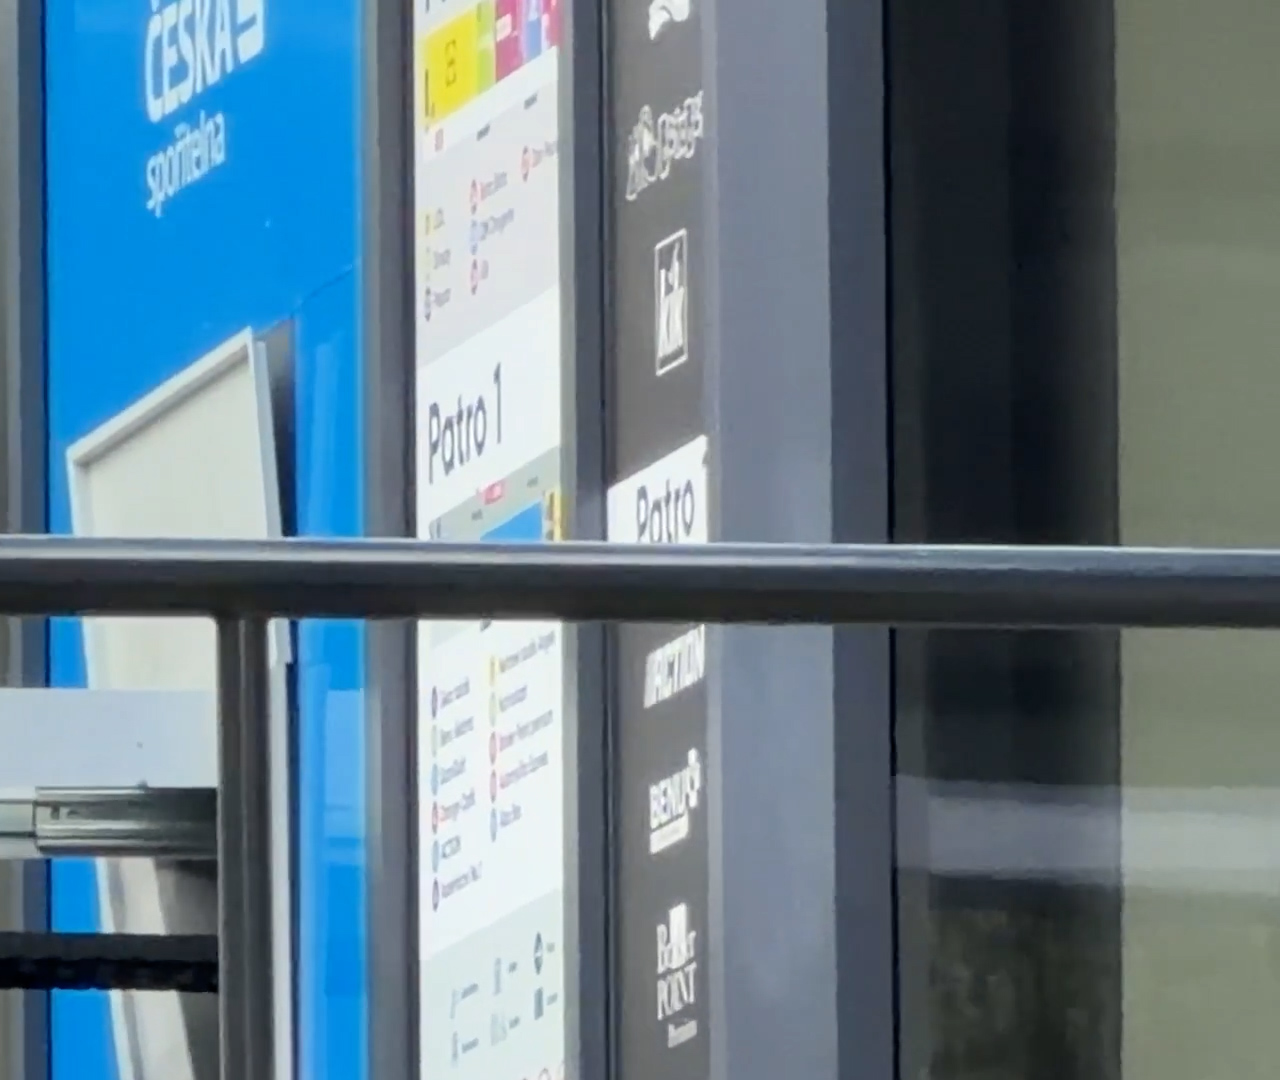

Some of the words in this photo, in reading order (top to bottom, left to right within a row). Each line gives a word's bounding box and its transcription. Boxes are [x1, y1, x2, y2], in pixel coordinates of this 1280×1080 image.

[146, 109, 226, 219] spořitelna
[428, 393, 487, 484] Patro
[493, 361, 502, 444] 1
[636, 478, 695, 543] Patro
